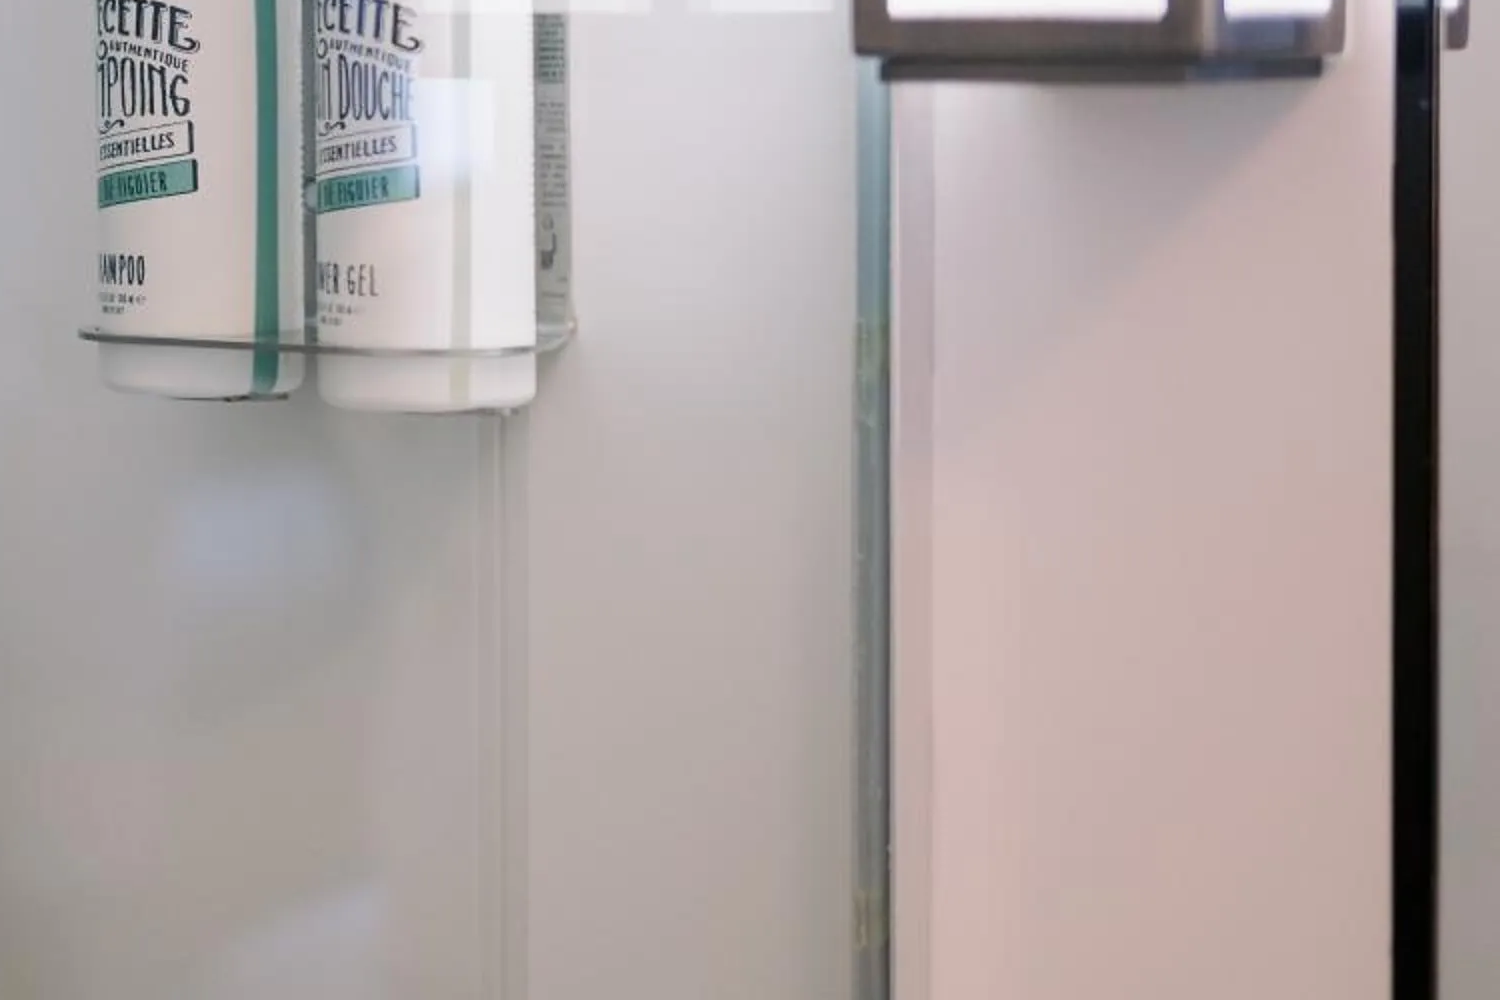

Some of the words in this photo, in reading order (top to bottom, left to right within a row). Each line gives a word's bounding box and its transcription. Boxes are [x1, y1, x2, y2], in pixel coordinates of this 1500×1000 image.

[109, 40, 189, 74] AUTHENTIQUE
[338, 53, 413, 121] DOUCHE
[347, 263, 380, 297] GEL
